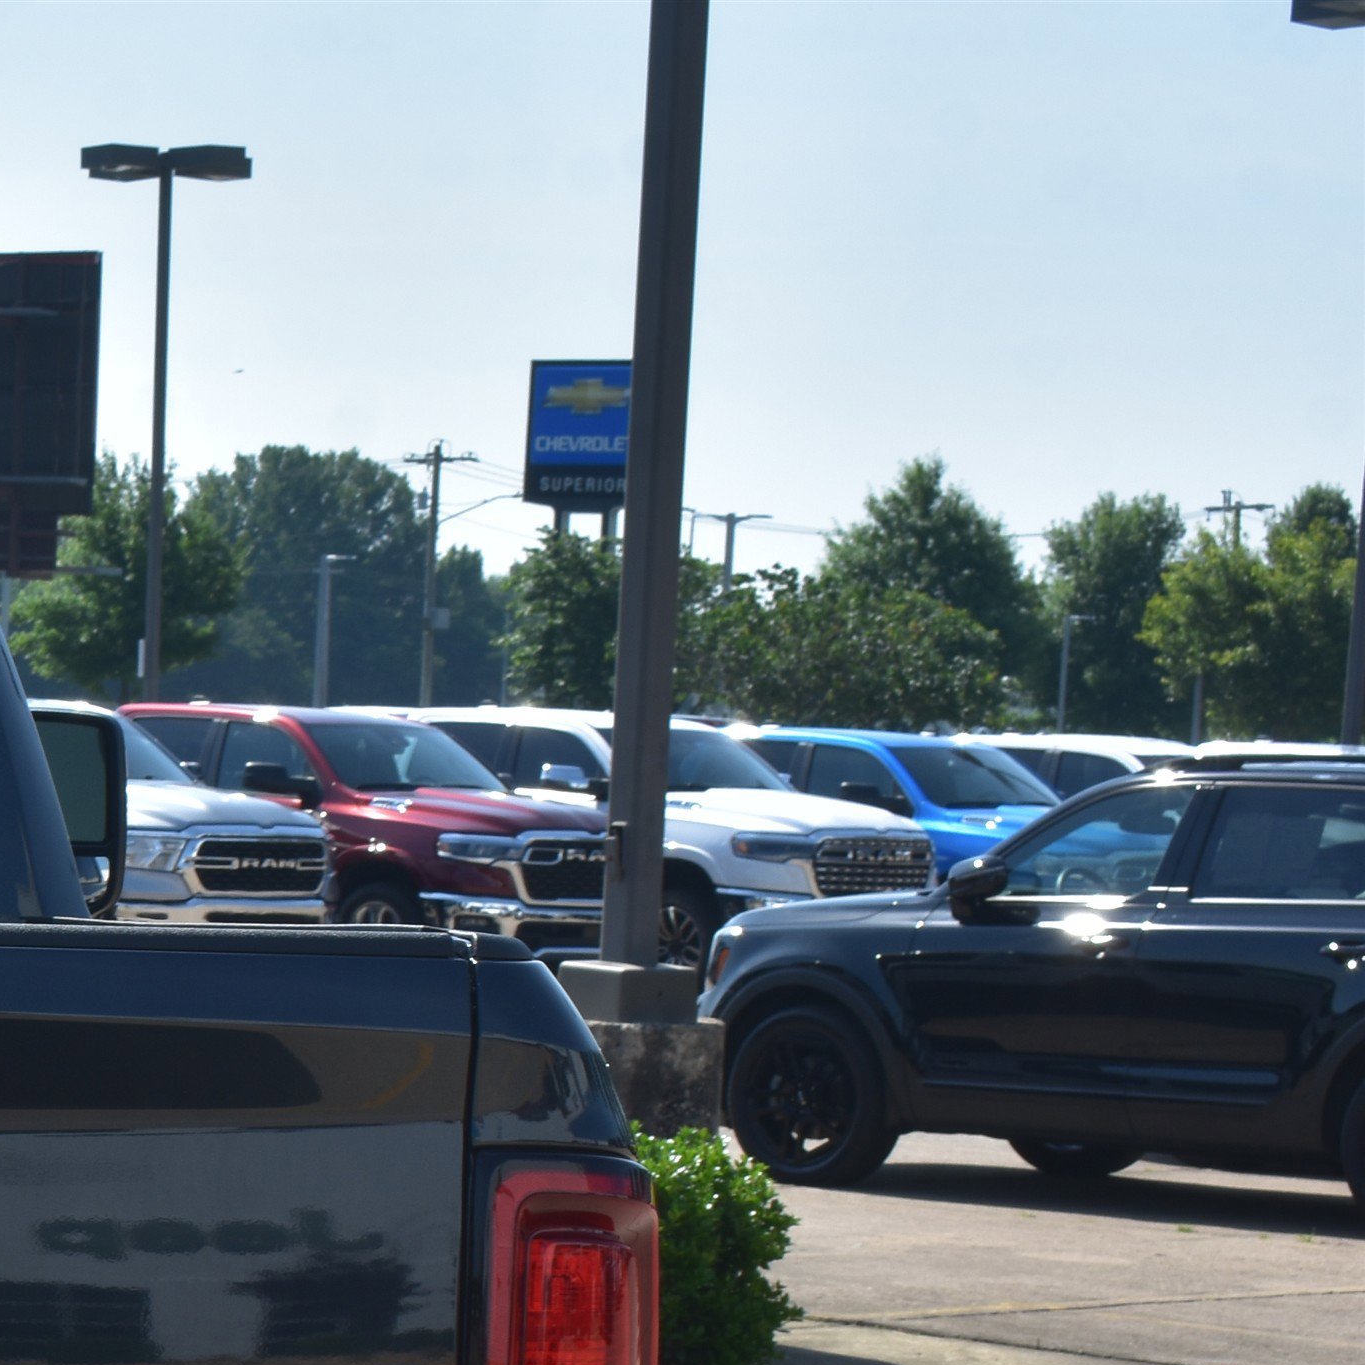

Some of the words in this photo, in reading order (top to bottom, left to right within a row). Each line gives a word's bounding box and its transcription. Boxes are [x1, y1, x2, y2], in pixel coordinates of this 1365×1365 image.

[534, 435, 630, 452] CHEVROLE
[540, 476, 627, 493] SUPERIOR
[566, 848, 607, 862] RA
[241, 857, 298, 869] RAM
